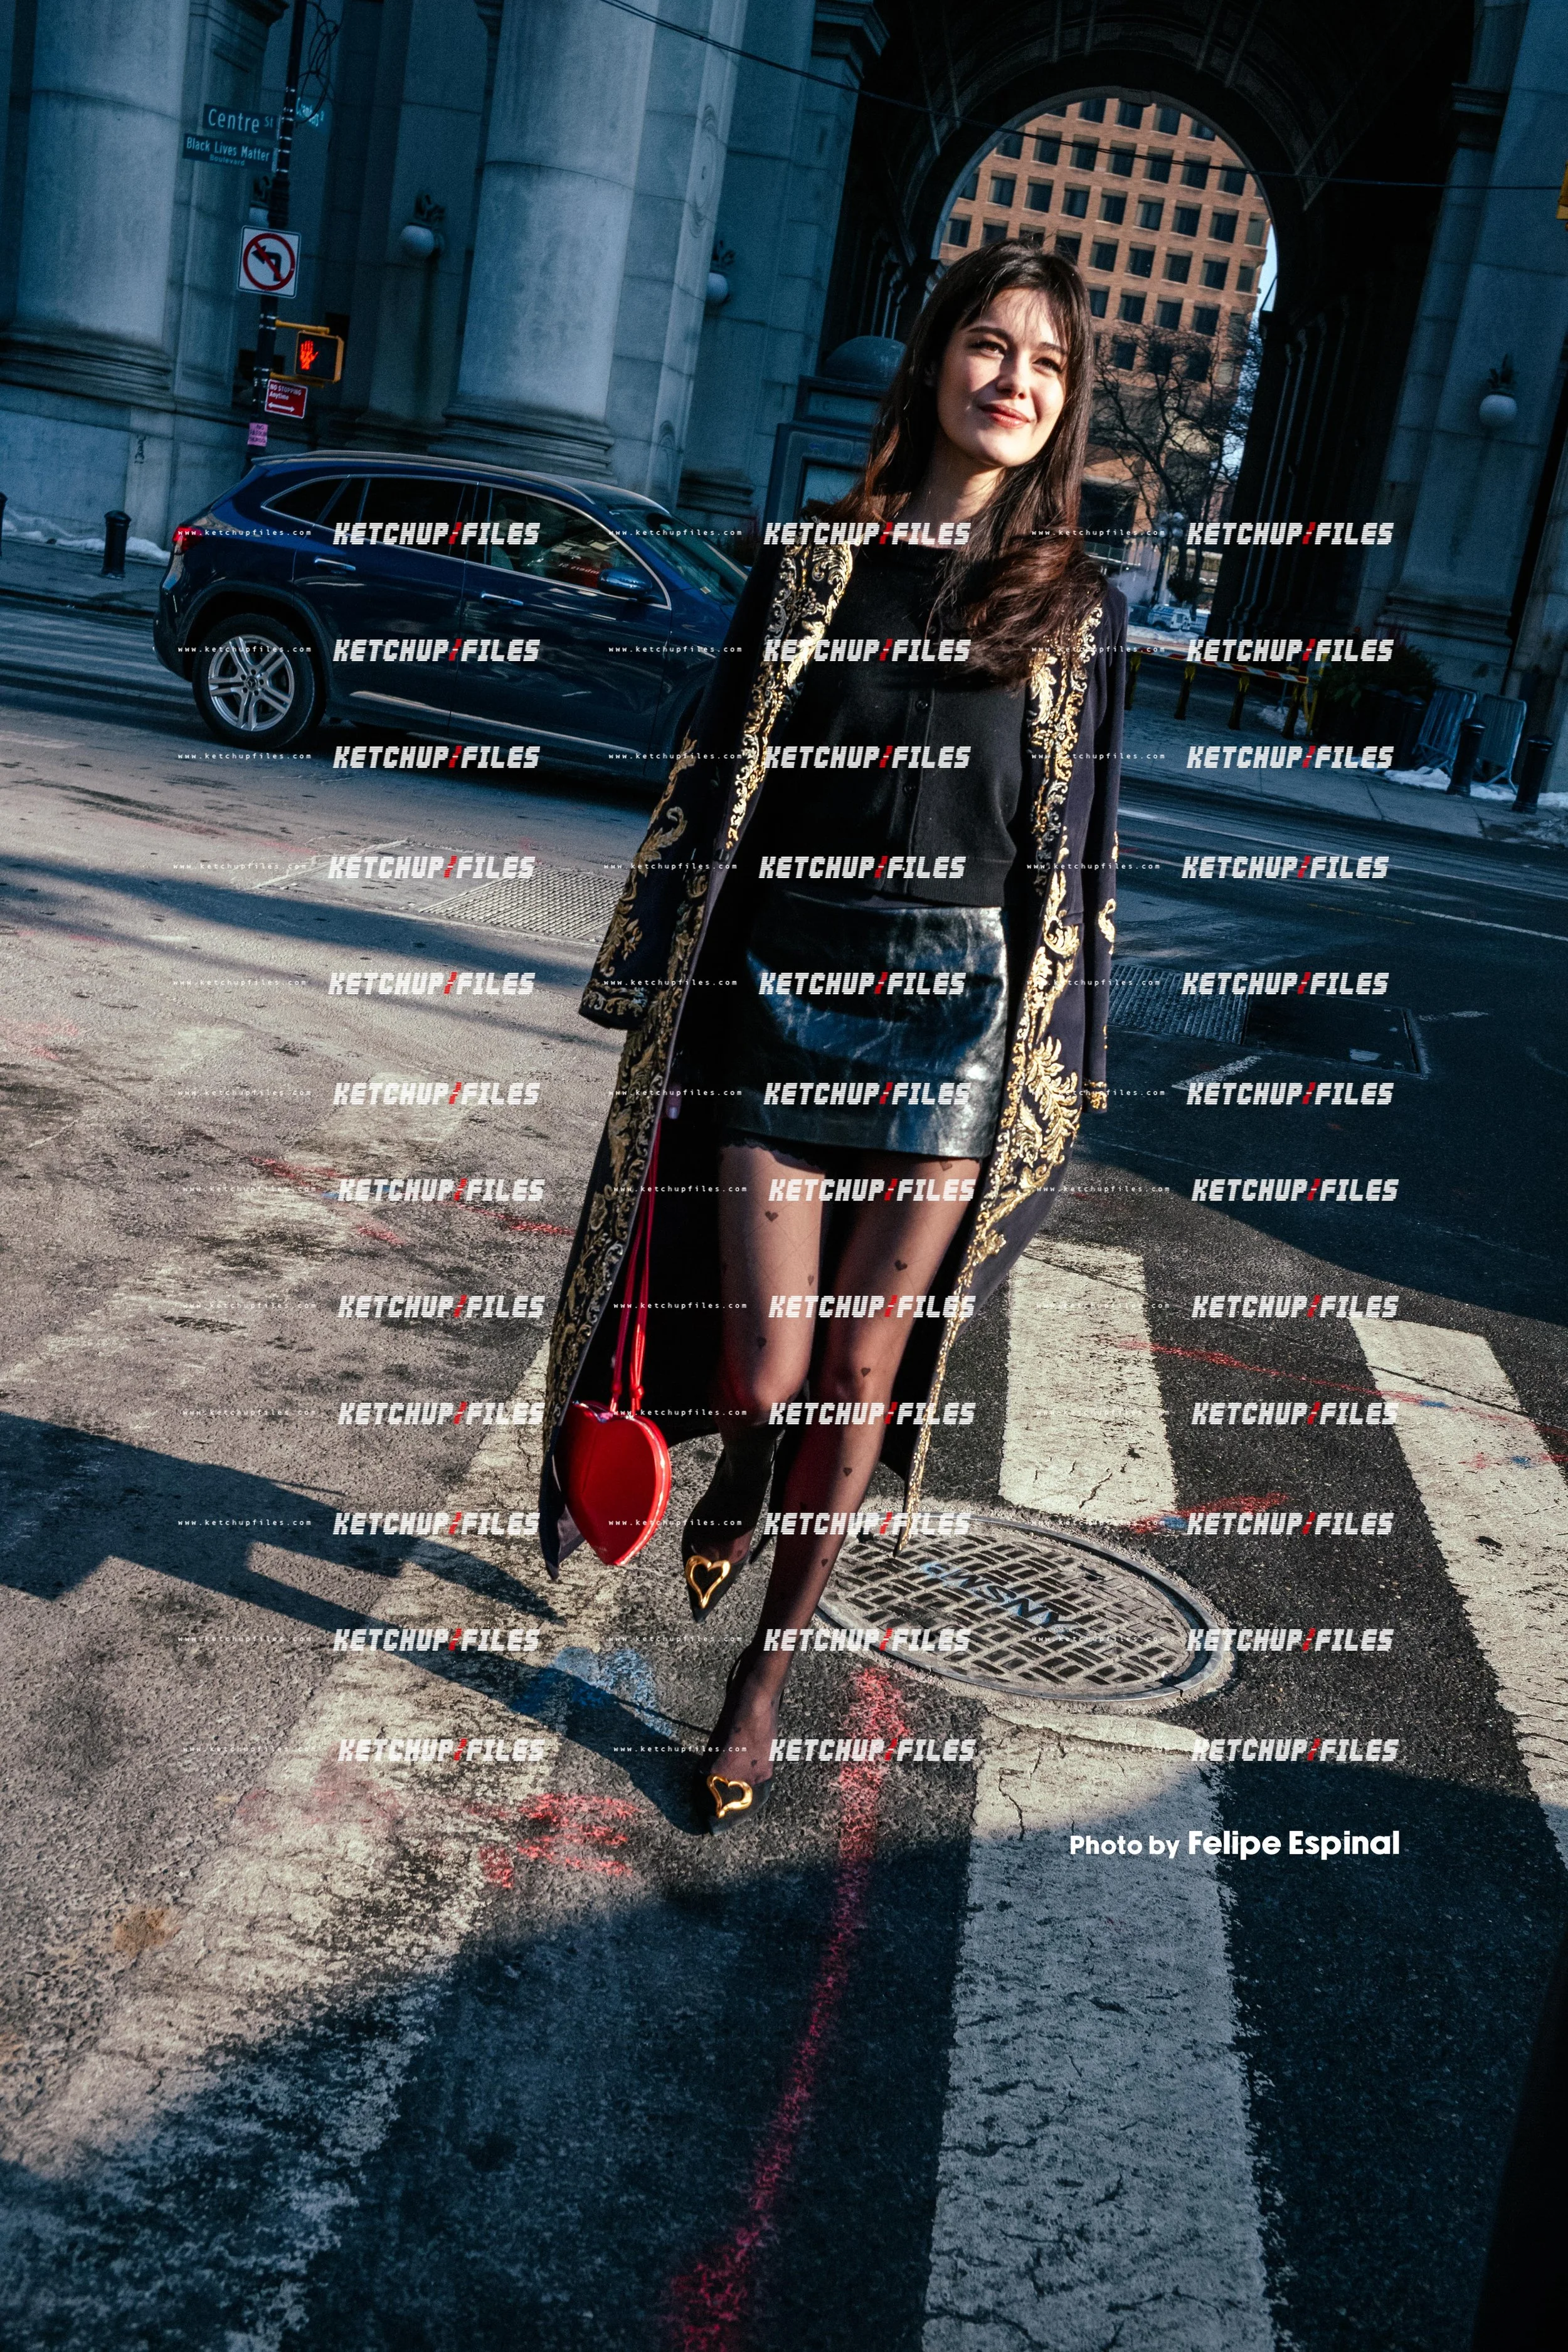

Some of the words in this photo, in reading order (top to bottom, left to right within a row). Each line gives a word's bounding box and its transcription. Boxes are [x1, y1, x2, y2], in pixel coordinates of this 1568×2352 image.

[208, 108, 259, 133] Centre
[264, 115, 273, 129] St
[186, 136, 211, 152] Black
[215, 140, 237, 156] Lives
[241, 145, 270, 162] Matter
[209, 154, 246, 166] Boulevard
[269, 391, 289, 401] Anytime
[278, 385, 302, 396] STOPPING
